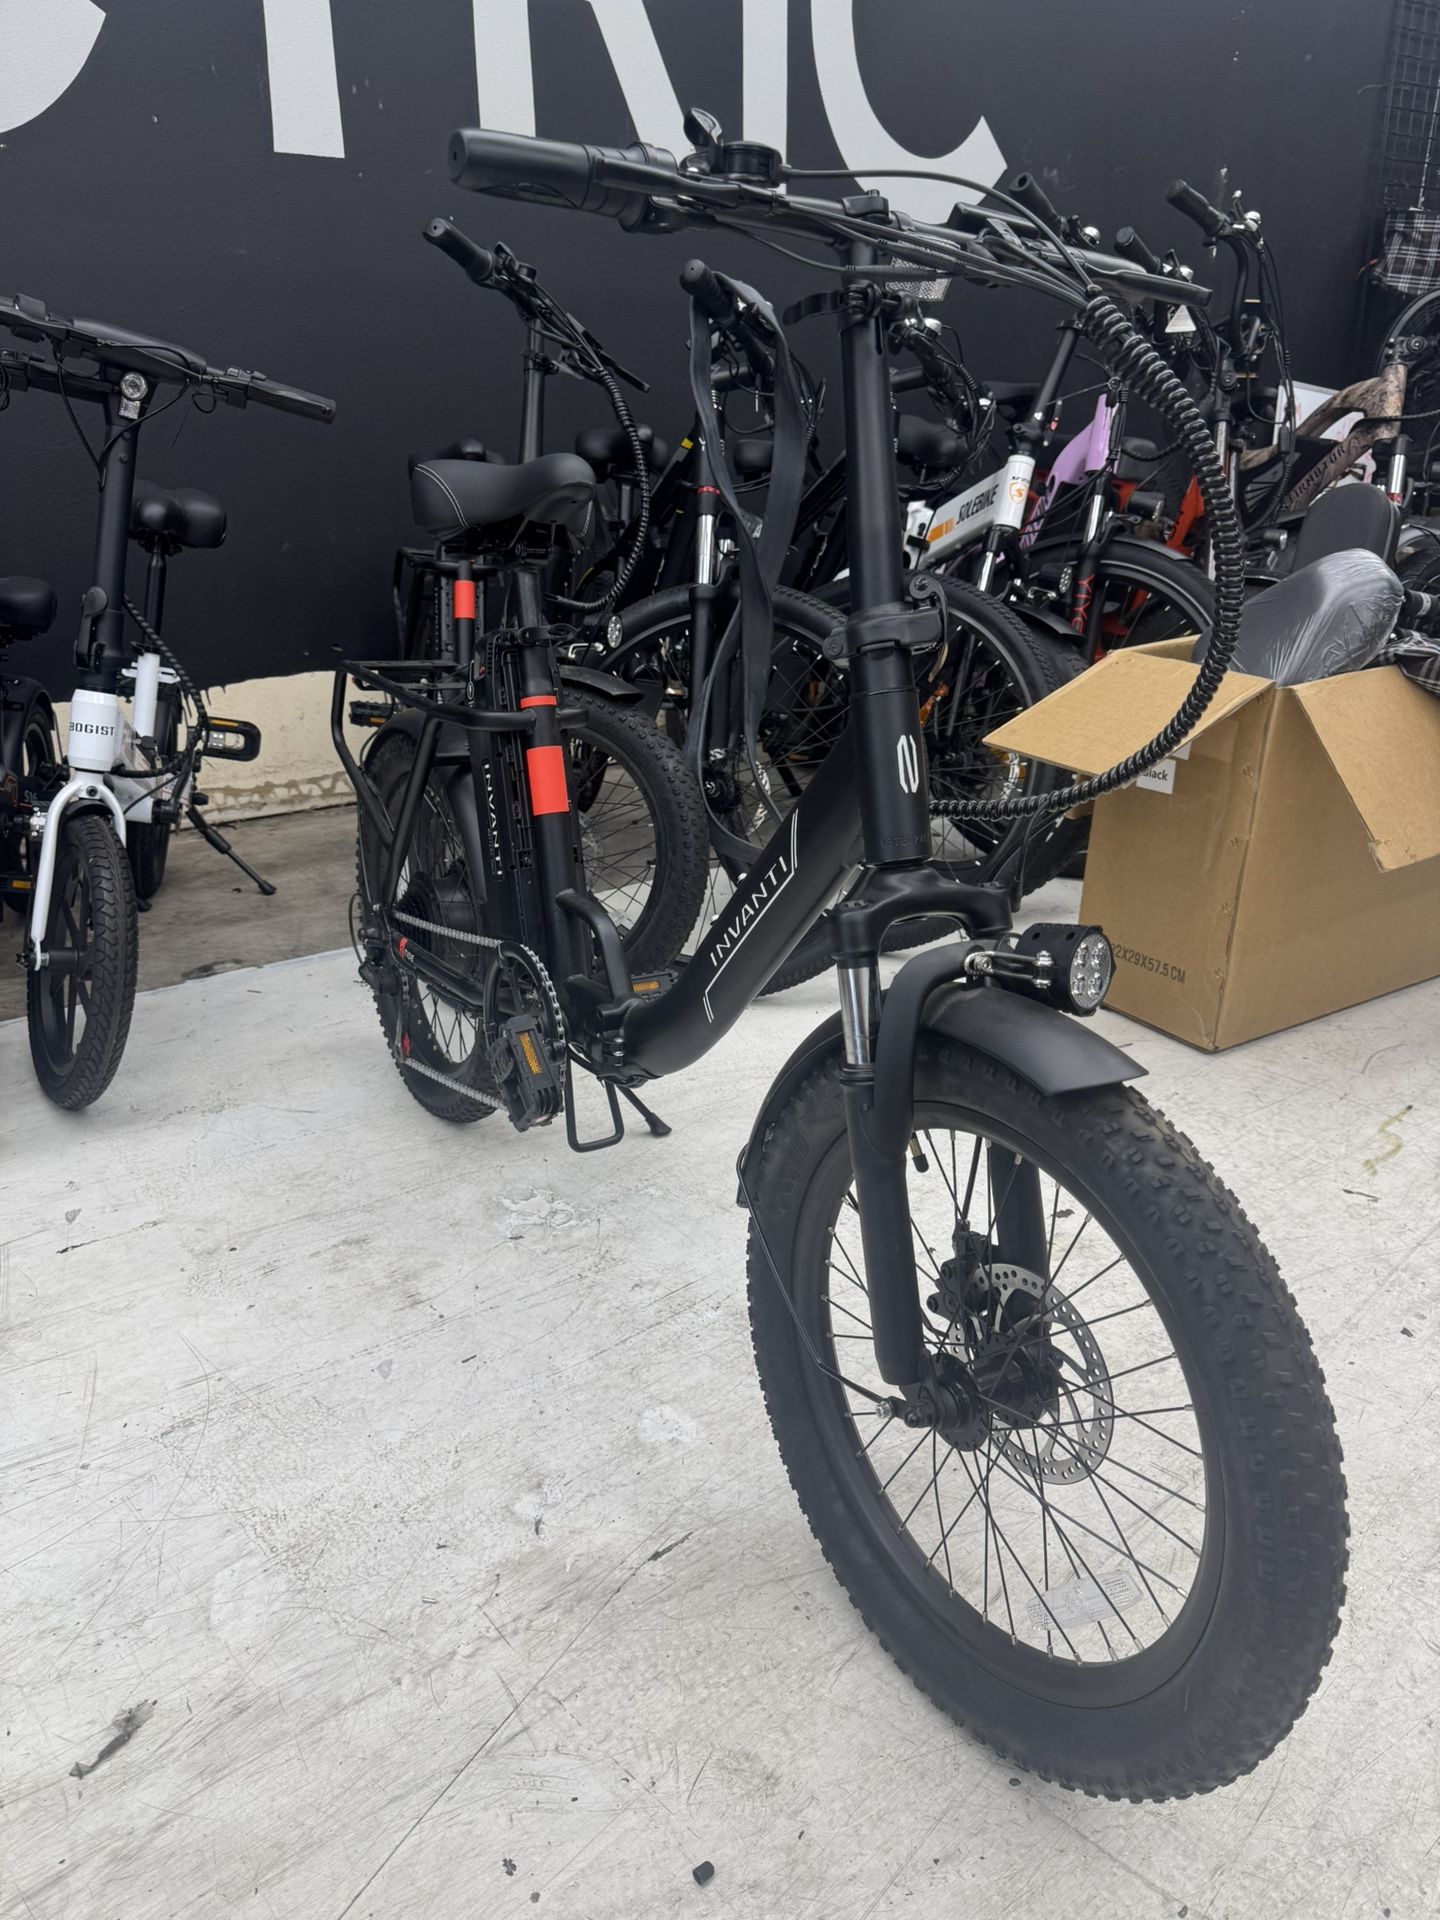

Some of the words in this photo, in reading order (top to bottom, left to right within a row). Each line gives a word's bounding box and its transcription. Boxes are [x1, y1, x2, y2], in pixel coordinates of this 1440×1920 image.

[956, 483, 999, 525] SOLEBIKE
[69, 721, 115, 736] BOGIST
[710, 855, 788, 967] INVANTI
[1170, 965, 1186, 984] CM
